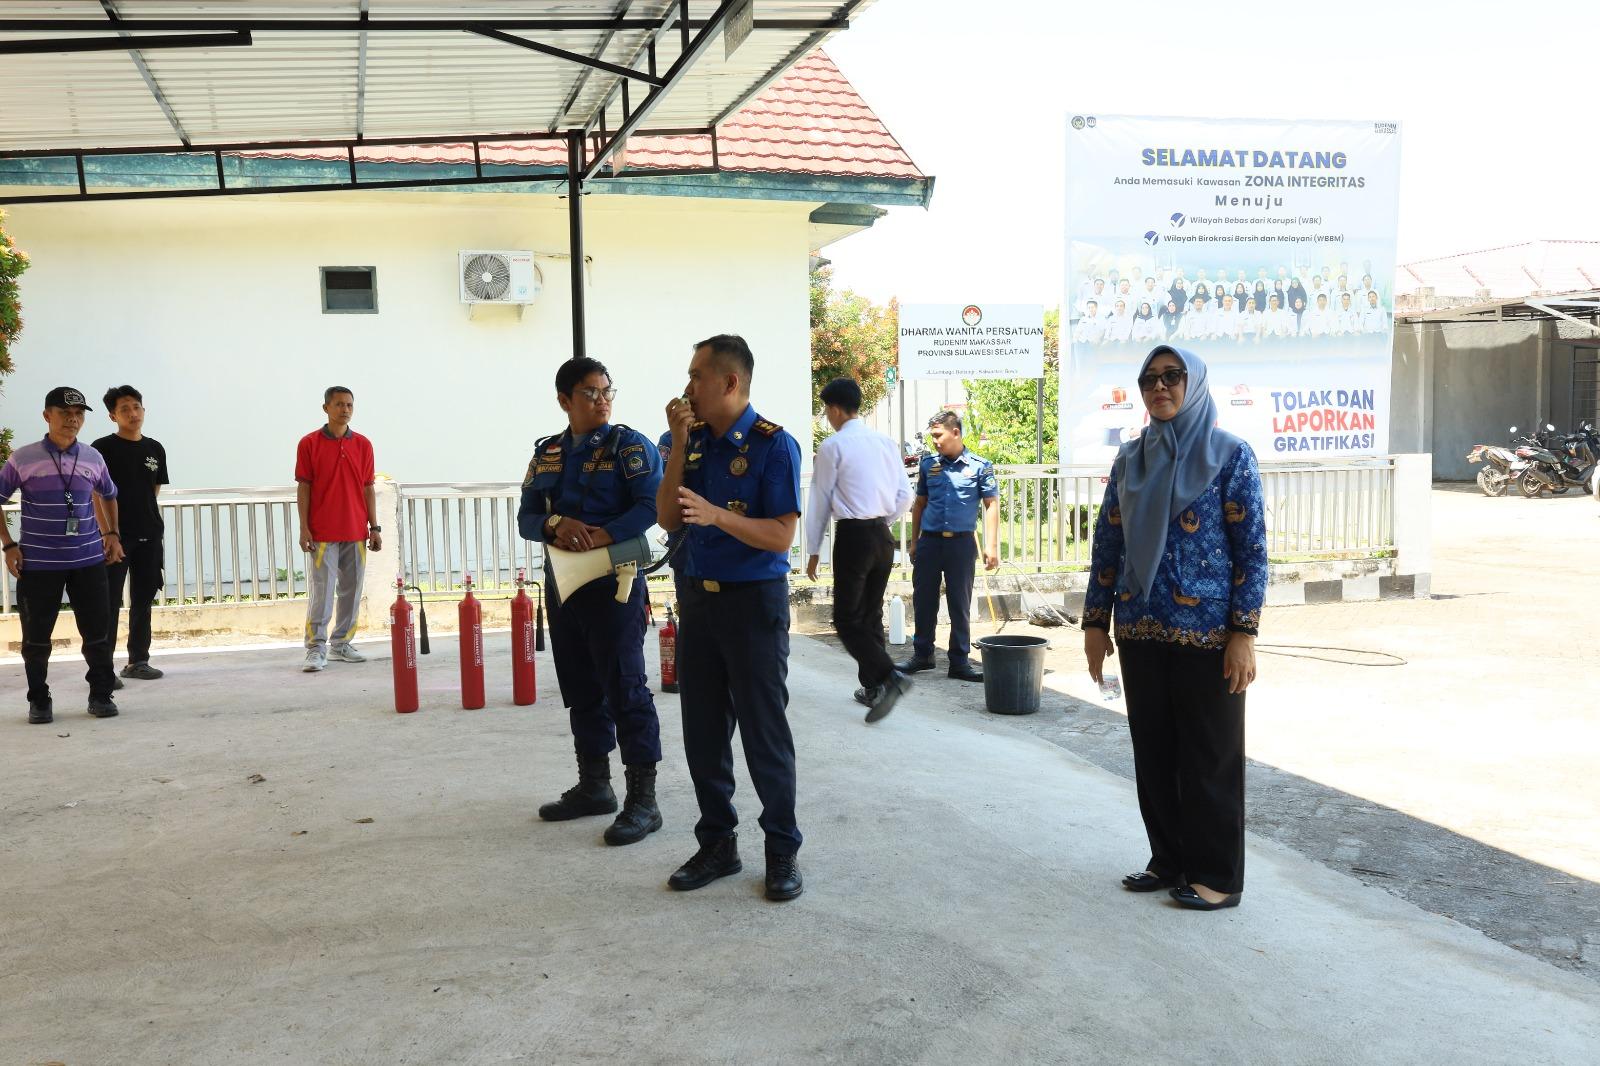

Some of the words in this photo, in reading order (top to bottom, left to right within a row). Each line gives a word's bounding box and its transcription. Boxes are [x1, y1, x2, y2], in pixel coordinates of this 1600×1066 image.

[1142, 148, 1249, 168] SELAMAT
[1253, 150, 1347, 169] DATANG
[1113, 177, 1140, 185] Anda
[1142, 177, 1193, 186] Memasuki
[1196, 177, 1241, 186] Kawasan
[1245, 176, 1285, 187] ZONA
[1287, 176, 1365, 188] INTEGRITAS
[1215, 194, 1283, 210] Menuju
[1190, 216, 1223, 226] Wilayah
[1224, 216, 1249, 224] Bebas
[1249, 216, 1266, 224] dari
[1267, 216, 1297, 226] Korupsi
[1298, 215, 1322, 226] (WBK)
[1164, 234, 1197, 244] Wilayah
[1198, 234, 1234, 242] Birokrasi
[1234, 234, 1259, 242] Bersih
[1260, 234, 1276, 242] dan
[1277, 234, 1313, 244] Melayani
[1314, 233, 1344, 244] (WBBM)
[901, 327, 944, 336] DHARMA
[945, 326, 984, 336] WANITA
[986, 327, 1044, 336] PERSATUAN
[969, 338, 1012, 346] MAKASSAR
[917, 349, 953, 357] PROVINSI
[994, 348, 1030, 356] SELATAN
[1270, 390, 1333, 413] TOLAK
[1336, 389, 1375, 410] DAN
[1272, 408, 1375, 433] LAPORKAN
[1273, 432, 1375, 452] GRATIFIKASI
